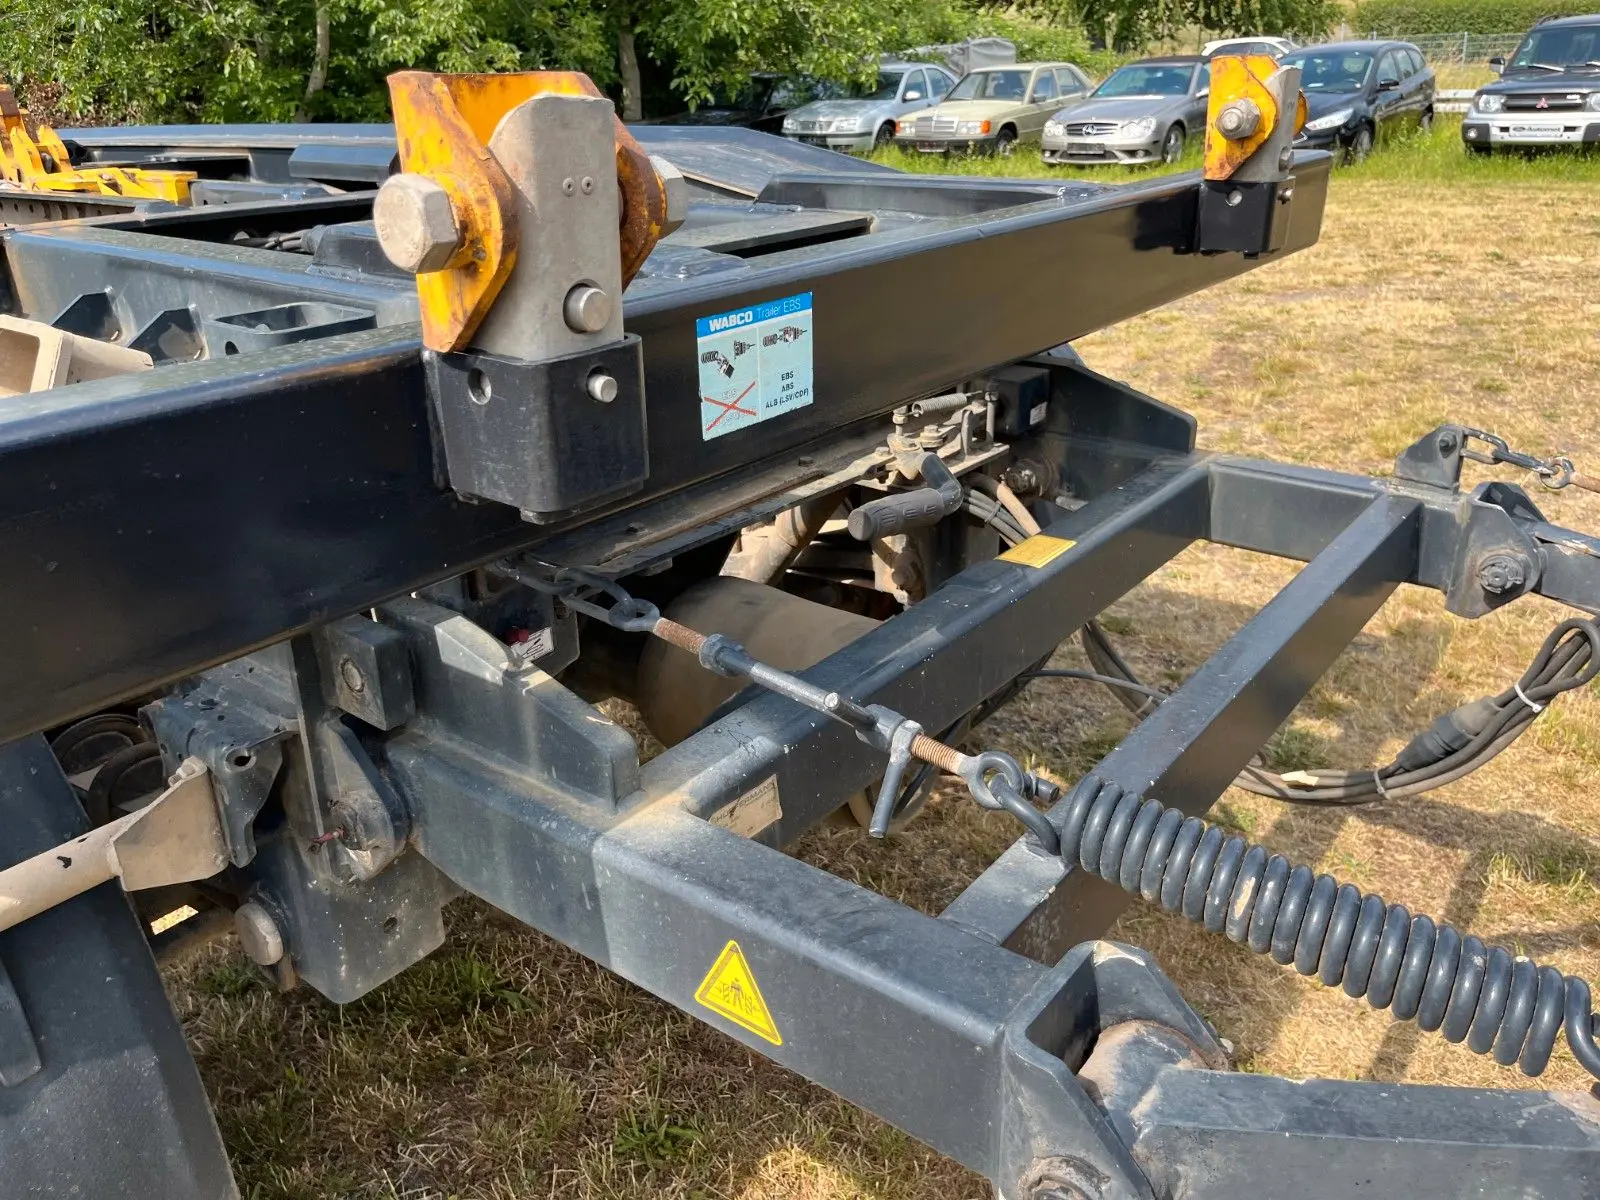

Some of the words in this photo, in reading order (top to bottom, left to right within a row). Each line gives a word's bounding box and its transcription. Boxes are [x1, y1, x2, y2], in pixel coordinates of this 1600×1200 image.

[709, 310, 753, 332] WABCO
[757, 304, 782, 319] Trailer
[783, 298, 801, 313] EBS
[781, 370, 794, 381] EBS
[781, 382, 794, 392] ABS
[766, 401, 778, 409] ALB
